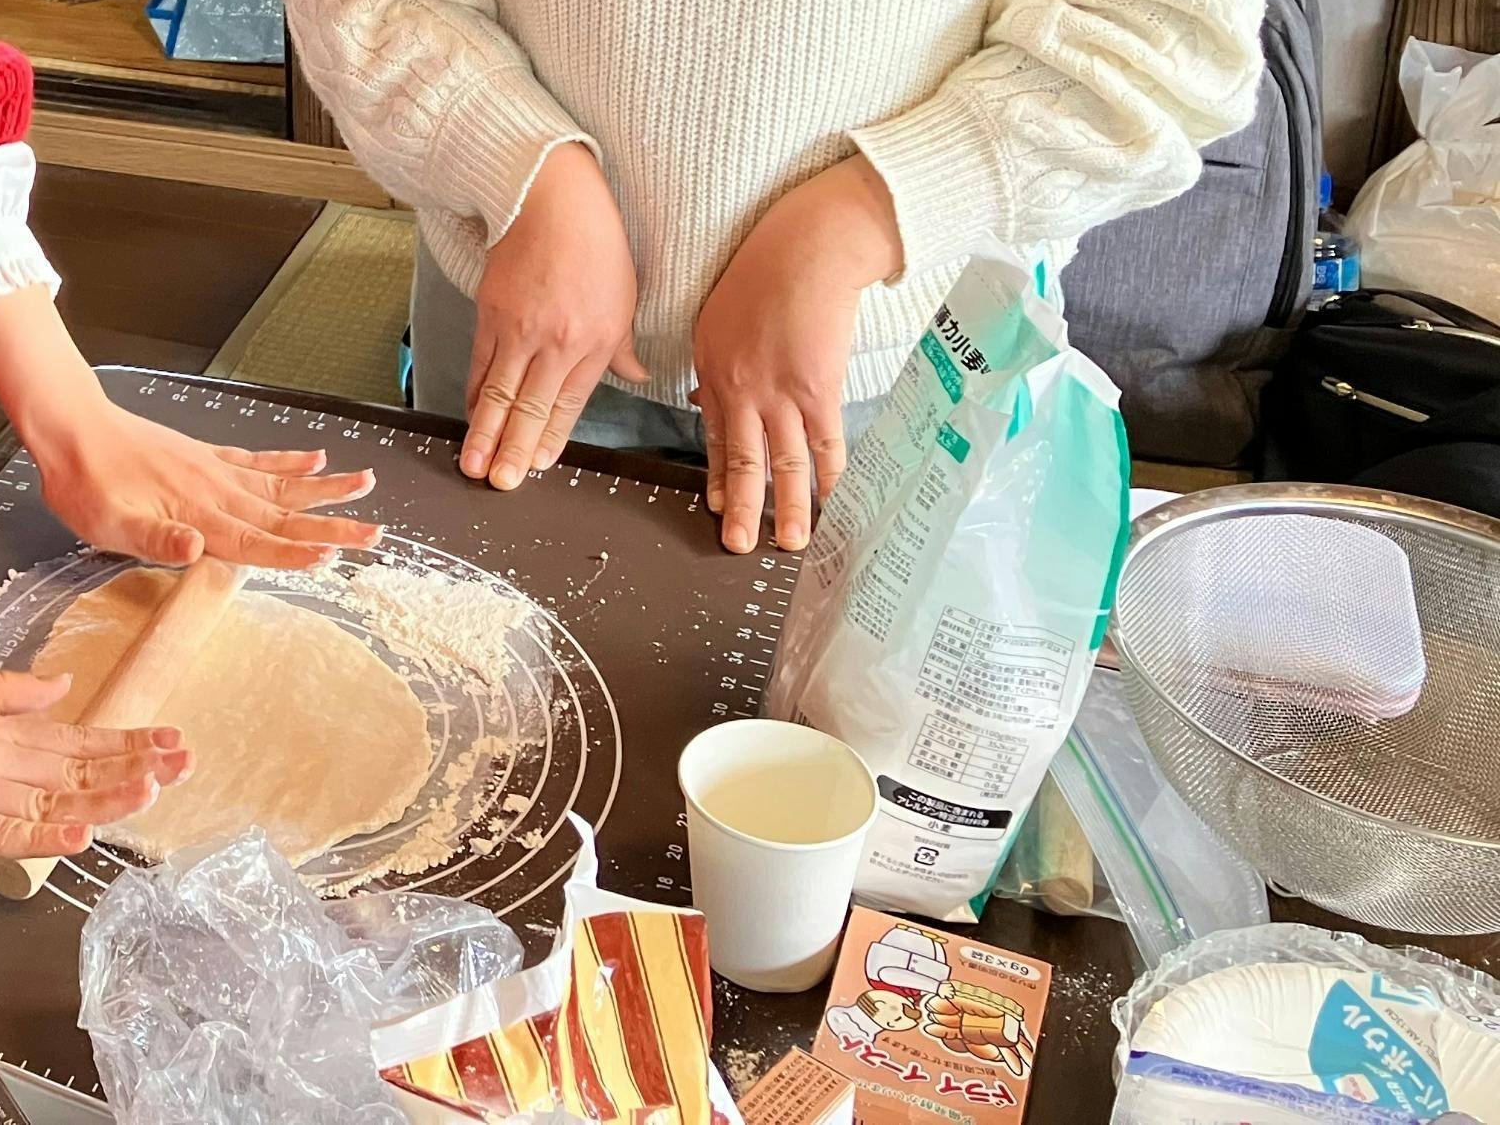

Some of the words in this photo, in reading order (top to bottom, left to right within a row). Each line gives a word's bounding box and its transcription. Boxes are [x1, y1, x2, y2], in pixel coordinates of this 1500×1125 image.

[138, 386, 155, 395] 32
[172, 392, 188, 402] 30
[273, 413, 290, 424] 24
[308, 420, 326, 430] 22
[343, 428, 361, 440] 20
[379, 437, 394, 448] 18
[569, 477, 579, 487] 8
[15, 481, 30, 491] 10
[0, 502, 15, 512] 12
[760, 556, 776, 571] 42
[753, 579, 768, 593] 40
[744, 602, 761, 617] 38
[737, 626, 753, 641] 36
[728, 650, 745, 665] 34
[720, 675, 738, 690] 32
[712, 702, 729, 717] 30
[927, 820, 952, 833] 小麦
[666, 844, 684, 861] 20
[656, 876, 674, 890] 18
[840, 1034, 930, 1083] イースト
[1343, 1004, 1445, 1116] パーボウル
[936, 1071, 1017, 1107] ドライ
